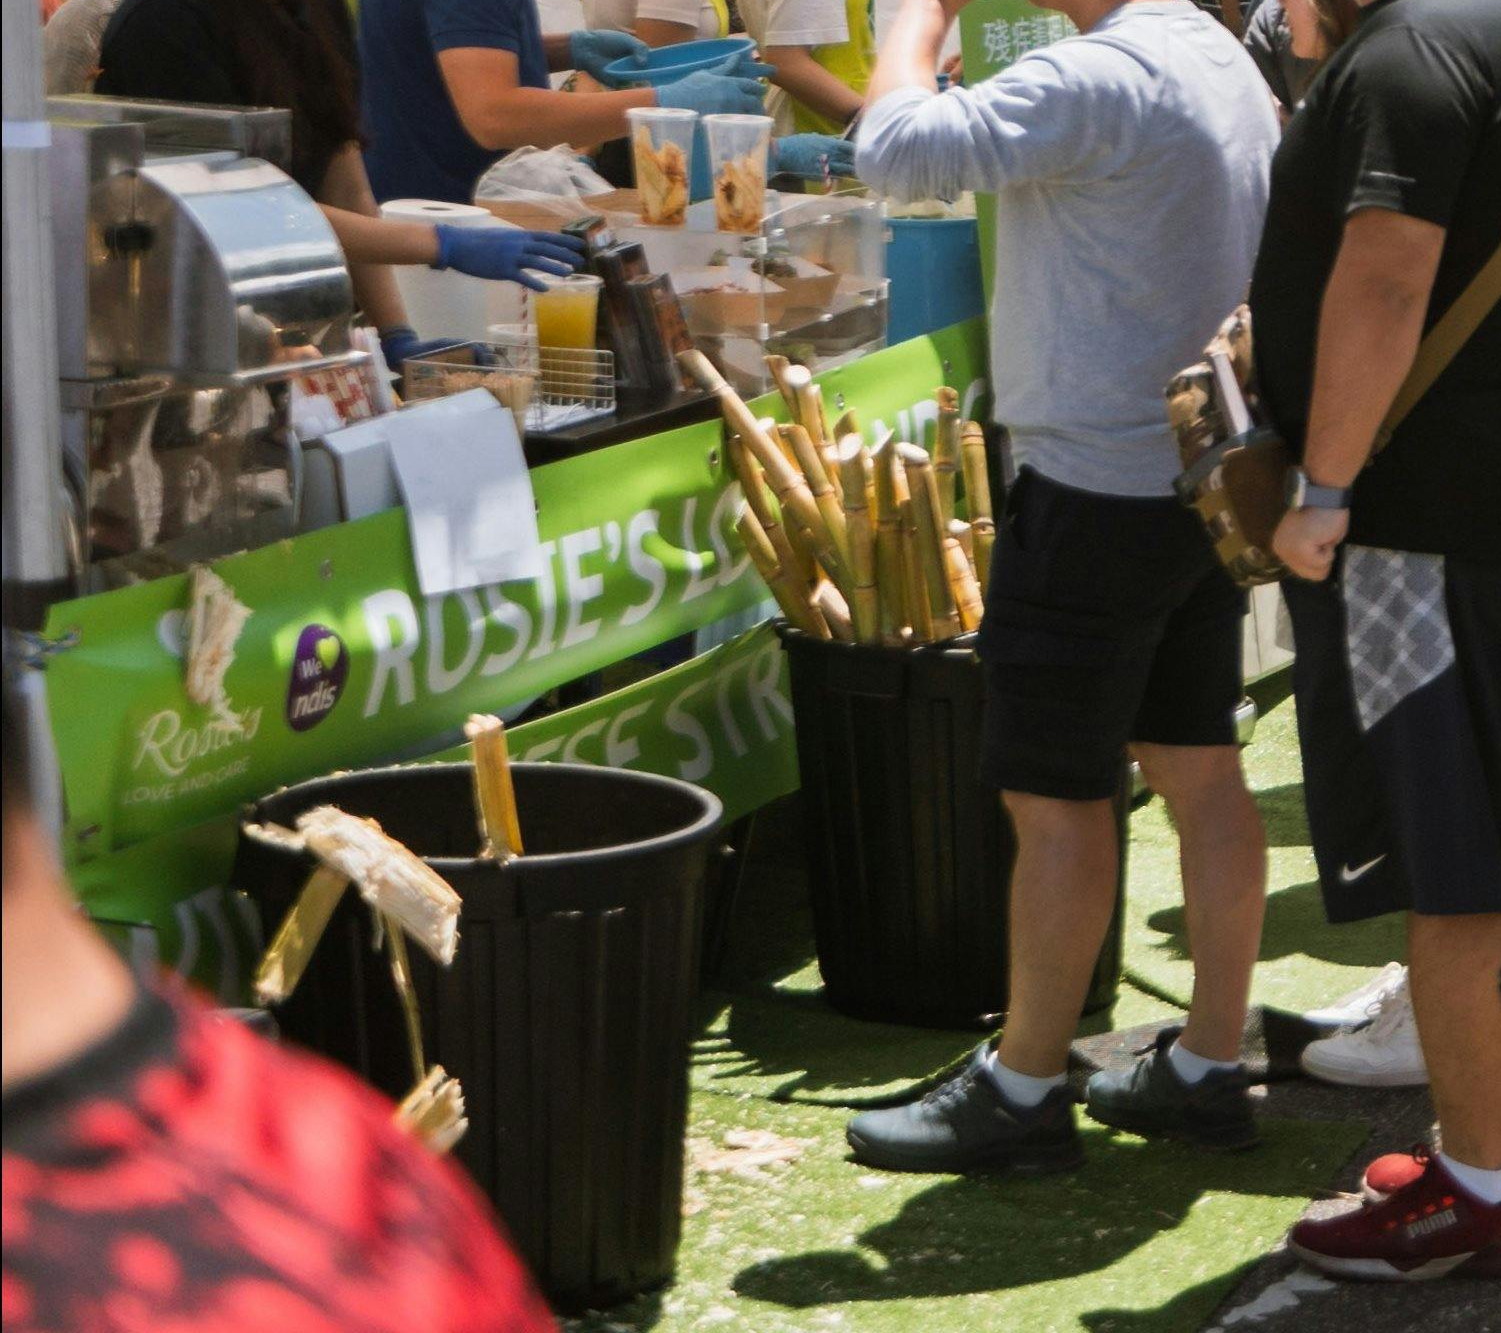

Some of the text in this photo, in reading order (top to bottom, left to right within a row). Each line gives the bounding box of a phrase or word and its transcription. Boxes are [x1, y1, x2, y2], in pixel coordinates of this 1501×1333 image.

[363, 508, 665, 720] ROSIE'S
[301, 657, 322, 680] We
[292, 682, 337, 720] ndis
[121, 785, 175, 806] LOVE
